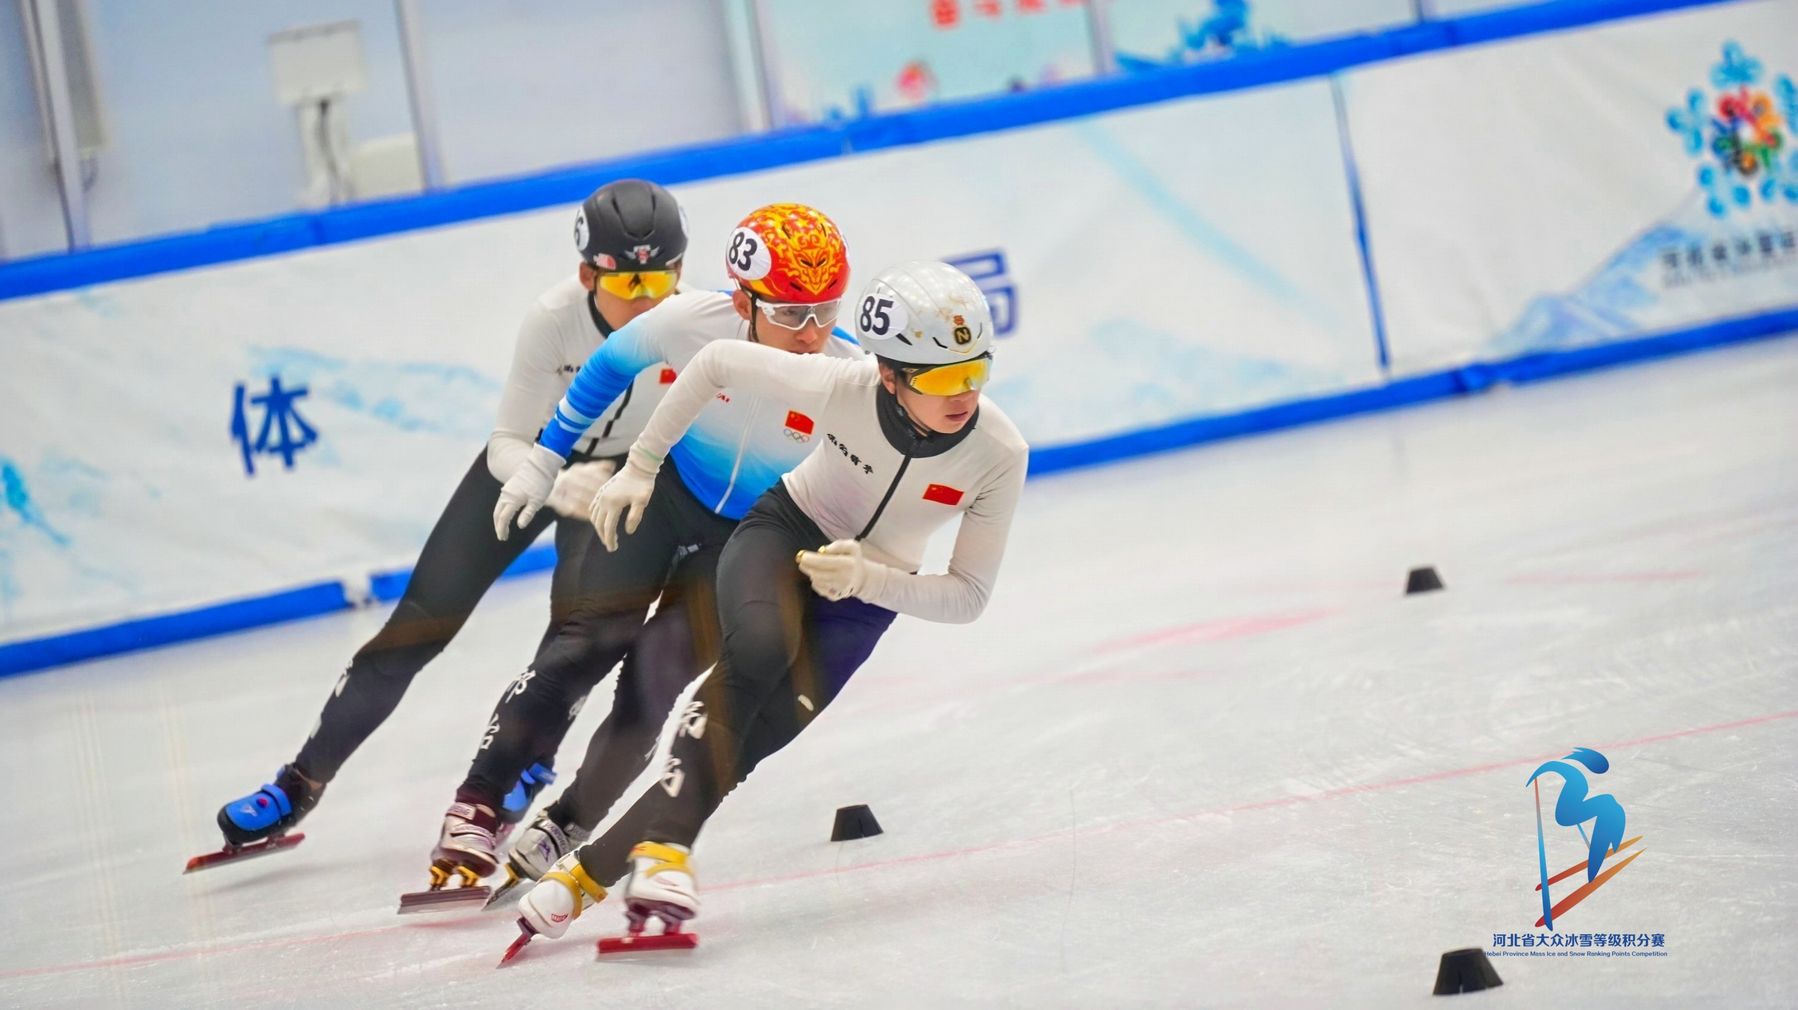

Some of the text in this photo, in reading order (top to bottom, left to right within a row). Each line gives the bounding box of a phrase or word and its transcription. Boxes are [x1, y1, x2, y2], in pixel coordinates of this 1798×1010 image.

[729, 231, 758, 271] 83
[860, 295, 894, 336] 85
[230, 376, 319, 476] 体
